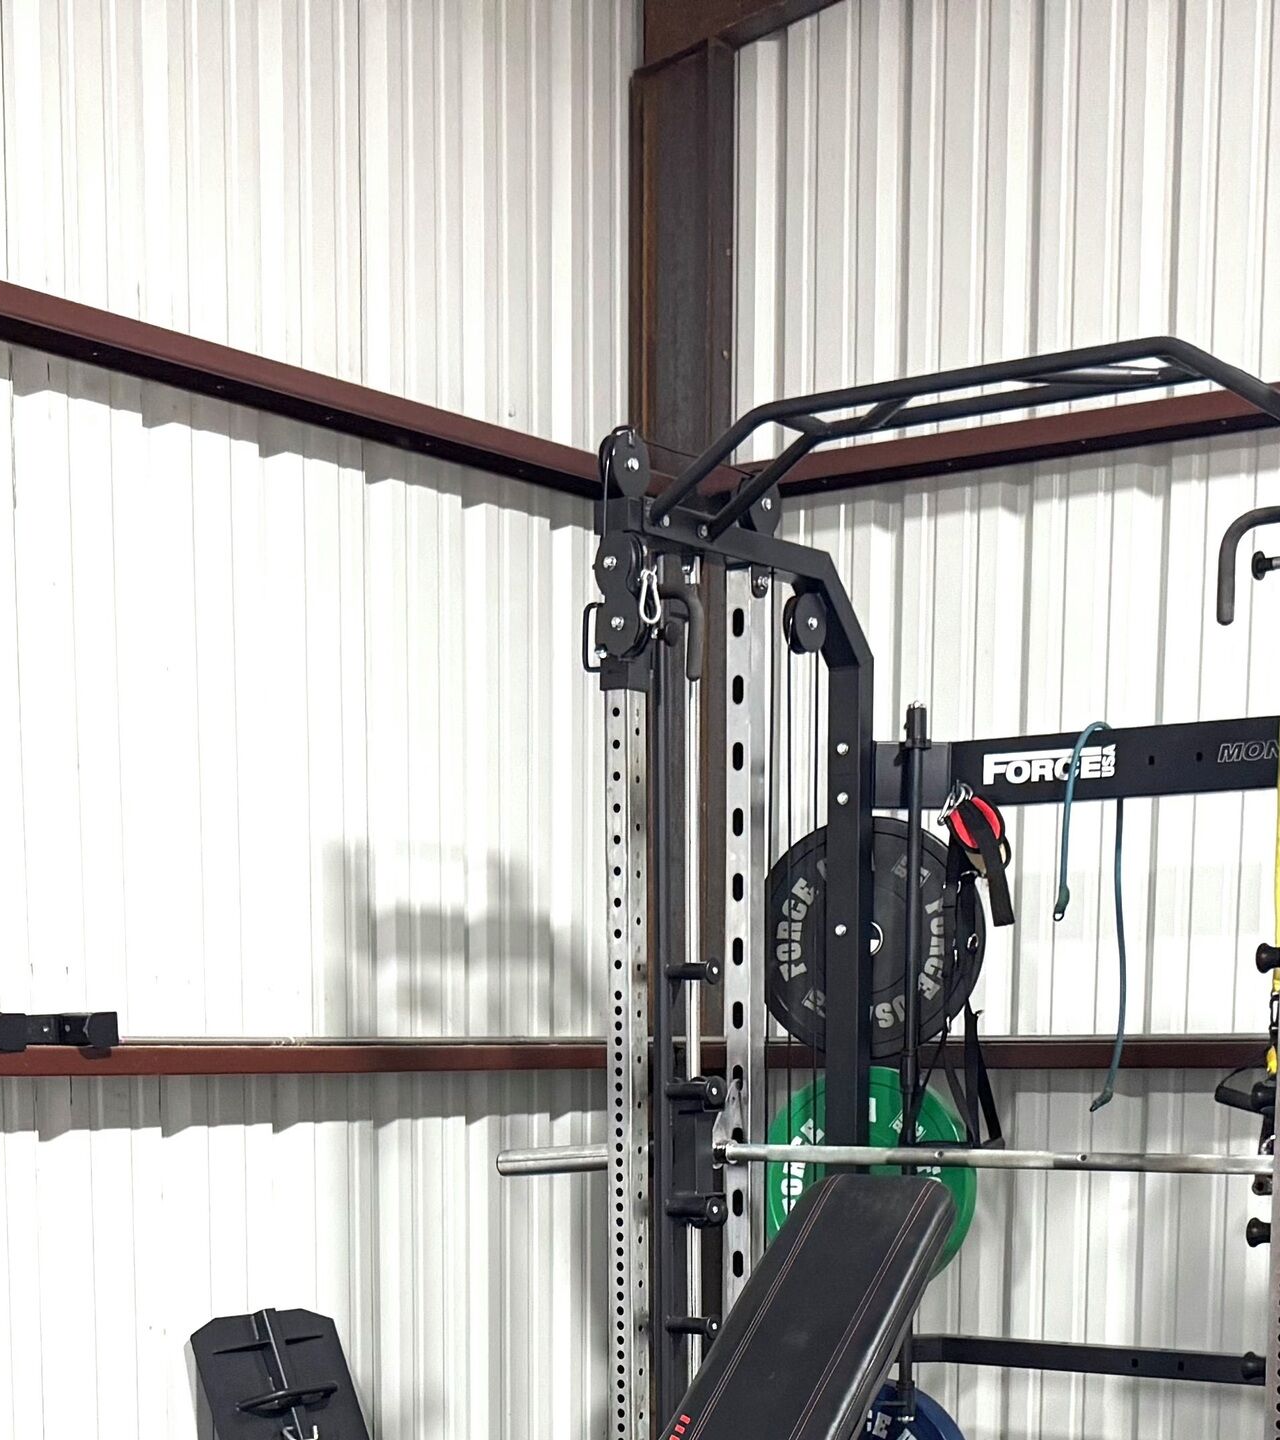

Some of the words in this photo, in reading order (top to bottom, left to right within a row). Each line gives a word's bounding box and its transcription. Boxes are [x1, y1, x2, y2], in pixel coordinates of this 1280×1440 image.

[983, 746, 1102, 786] FORCE
[1102, 744, 1117, 778] USA
[776, 876, 815, 983] FORCE
[870, 994, 906, 1029] US
